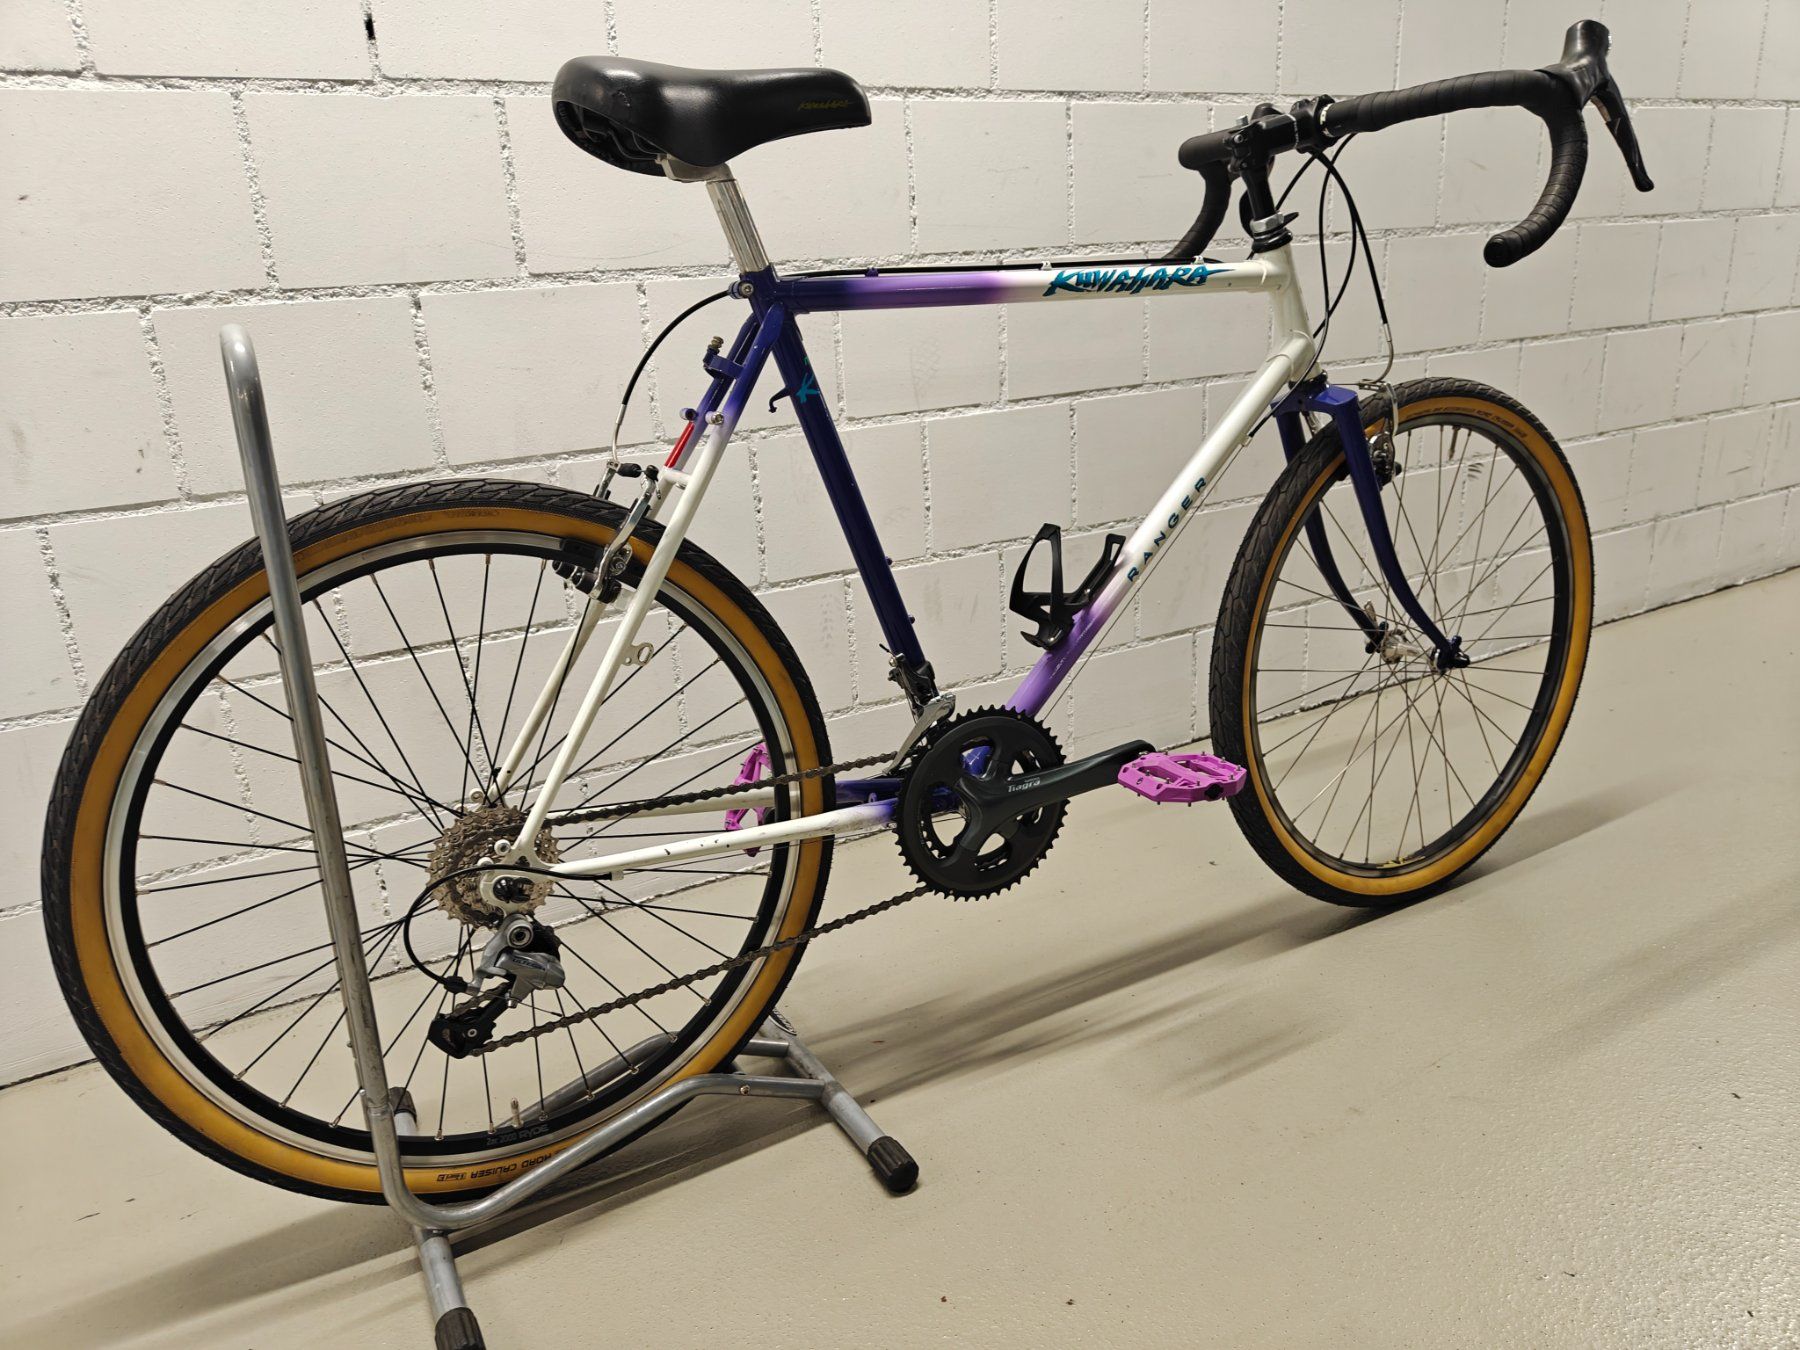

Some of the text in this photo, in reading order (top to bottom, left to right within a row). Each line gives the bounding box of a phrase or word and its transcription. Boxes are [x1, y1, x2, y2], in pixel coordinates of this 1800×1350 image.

[1043, 265, 1235, 297] KUWAHARA
[1127, 477, 1206, 582] RANGER
[1008, 780, 1040, 792] Tiagra
[518, 1124, 550, 1139] RYDE
[470, 1163, 518, 1179] CRUISER
